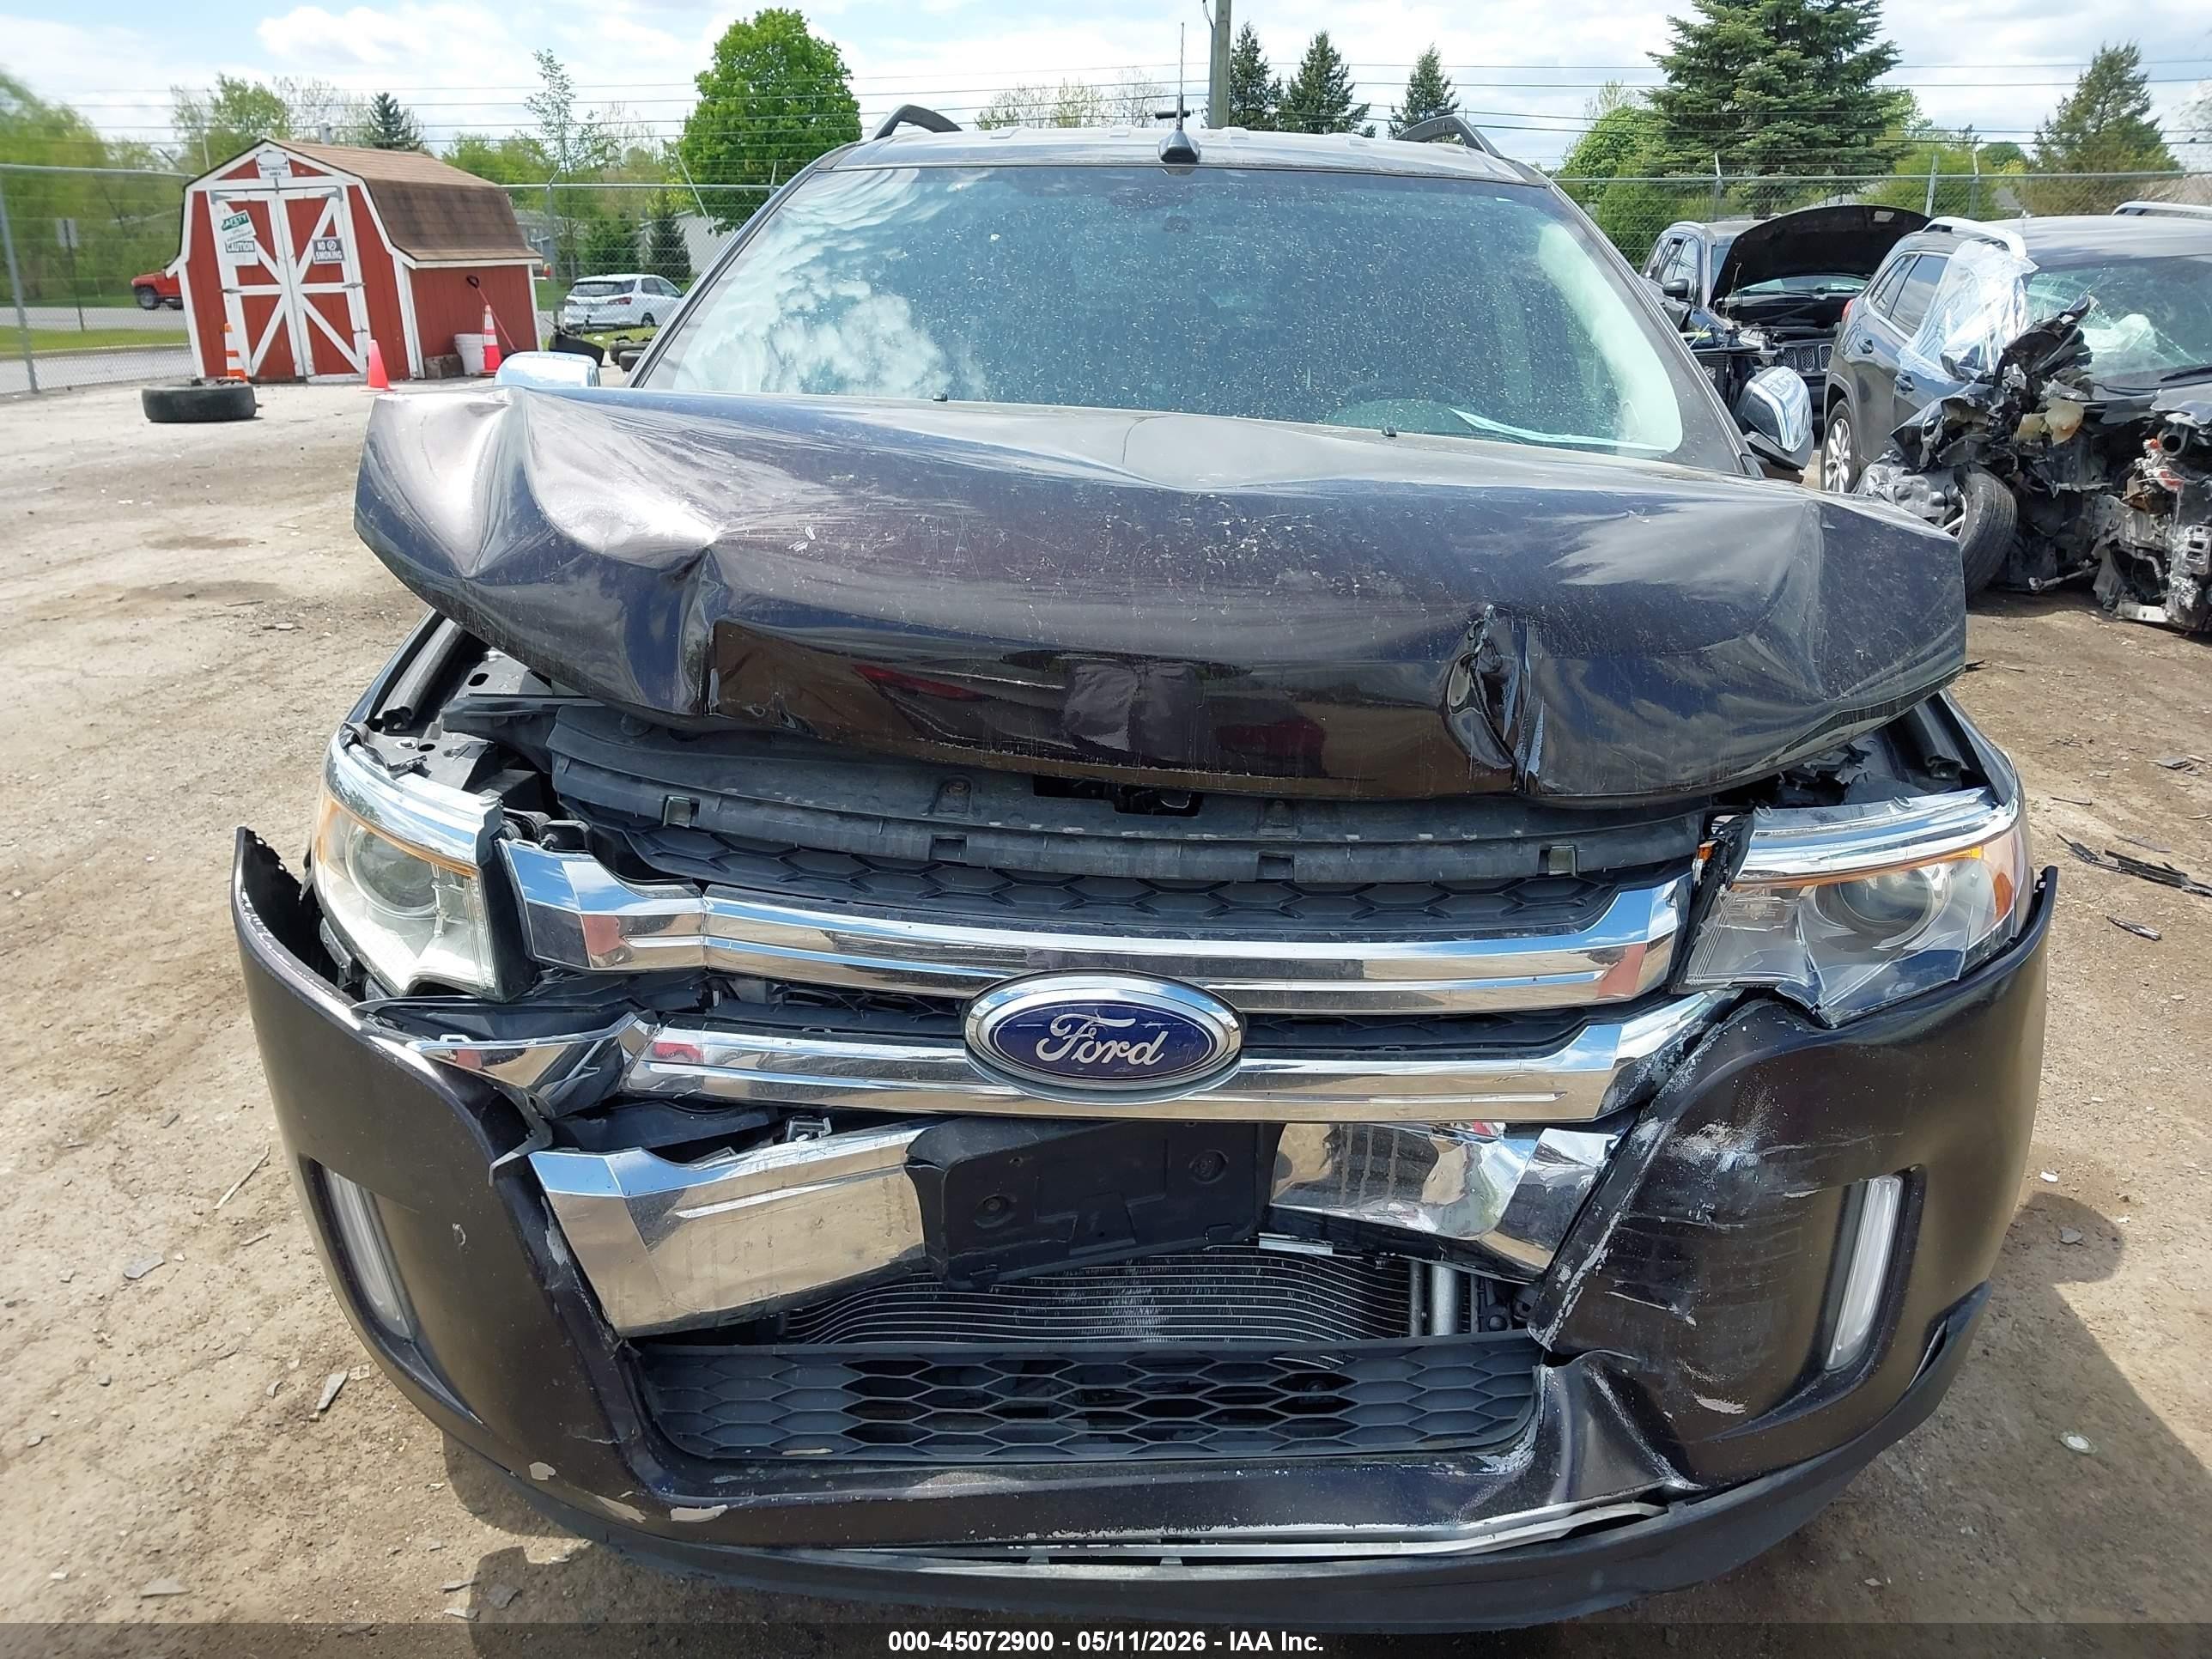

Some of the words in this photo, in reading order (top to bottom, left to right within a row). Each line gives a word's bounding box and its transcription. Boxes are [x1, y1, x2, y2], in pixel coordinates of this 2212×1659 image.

[227, 241, 254, 252] CAUTION
[317, 240, 325, 250] NO
[315, 250, 343, 260] SMOKING
[1036, 1013, 1169, 1066] Ford
